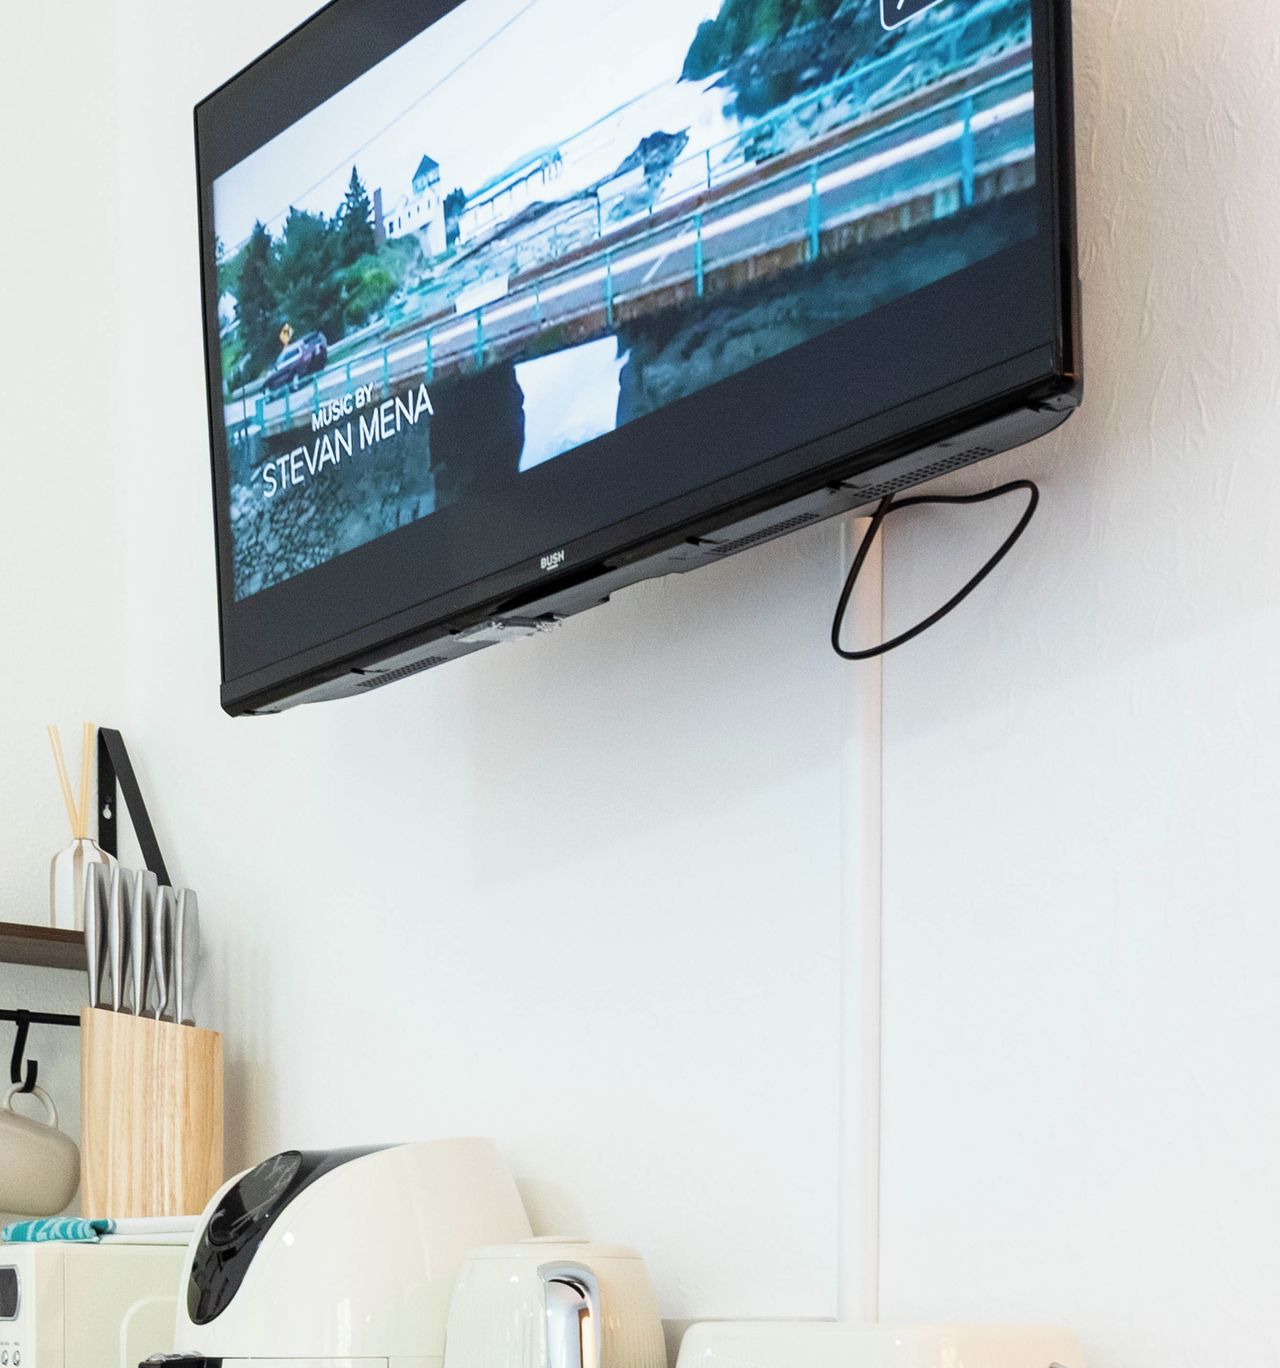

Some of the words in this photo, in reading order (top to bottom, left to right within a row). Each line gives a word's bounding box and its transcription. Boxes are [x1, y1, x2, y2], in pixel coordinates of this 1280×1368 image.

[312, 393, 353, 431] MUSIC
[355, 382, 374, 408] BY
[263, 422, 352, 498] STEVAN
[360, 383, 434, 450] MENA
[540, 549, 564, 569] BUSH
